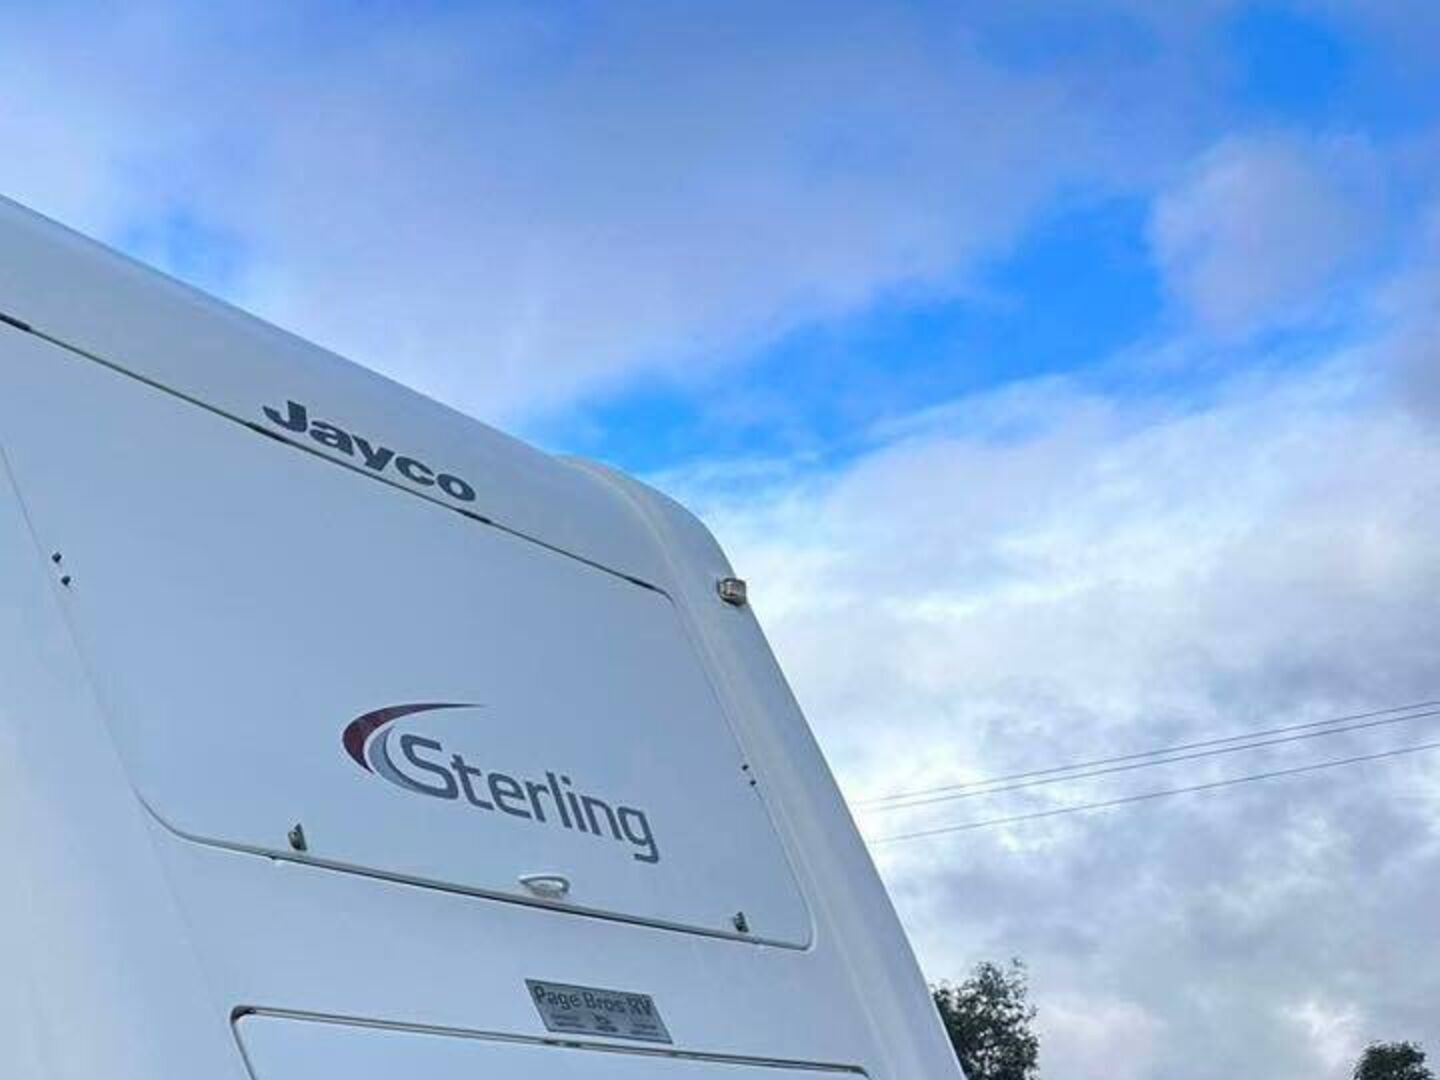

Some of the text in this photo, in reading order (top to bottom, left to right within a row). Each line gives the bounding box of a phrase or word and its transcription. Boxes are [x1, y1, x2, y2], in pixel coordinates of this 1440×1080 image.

[262, 400, 477, 501] Jayco
[382, 732, 660, 864] Sterling
[533, 985, 582, 1011] Page
